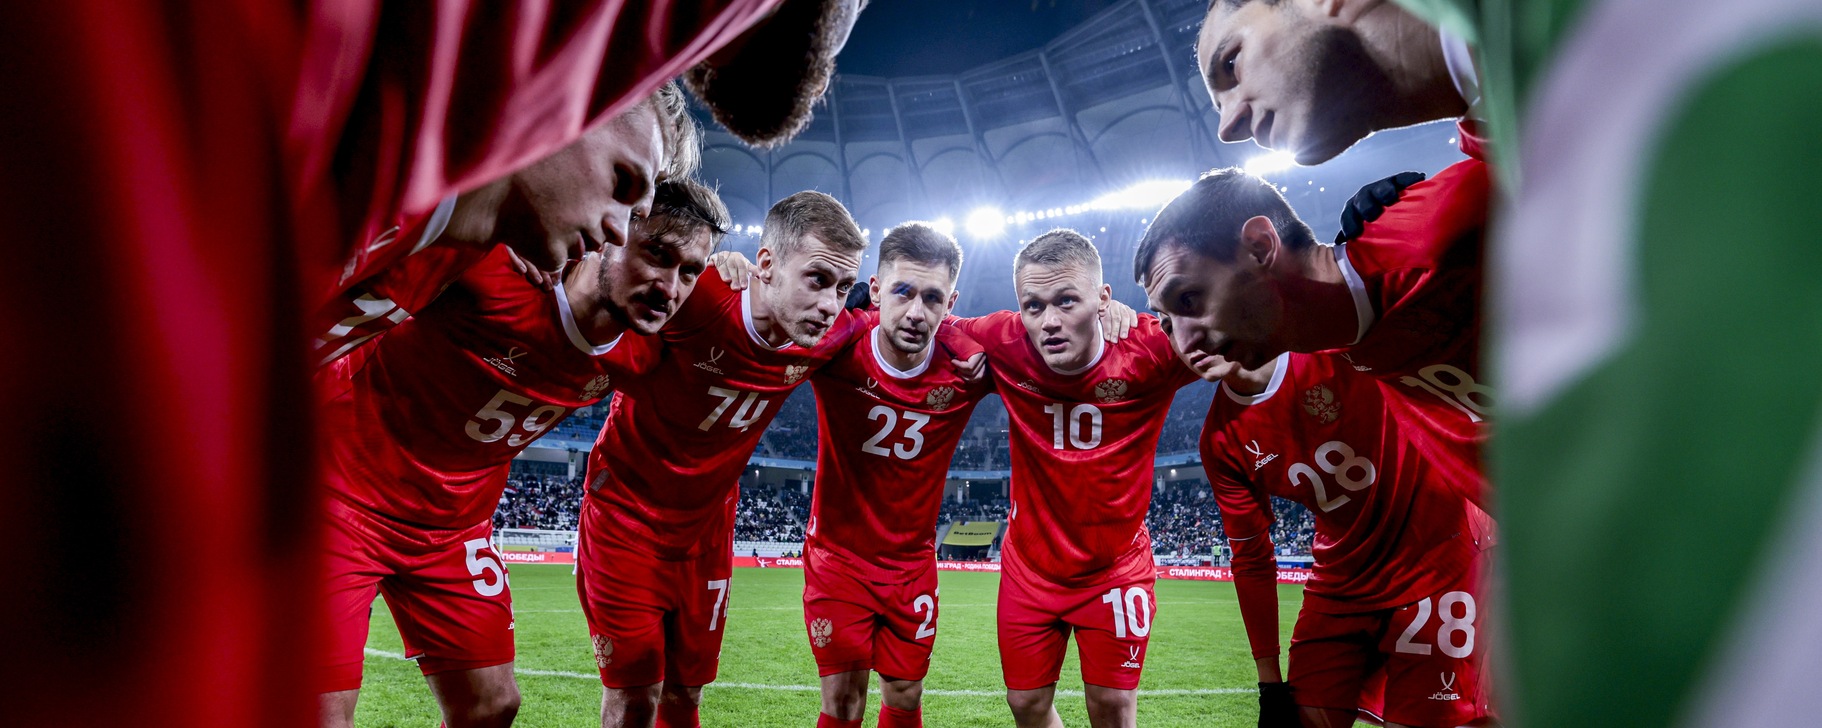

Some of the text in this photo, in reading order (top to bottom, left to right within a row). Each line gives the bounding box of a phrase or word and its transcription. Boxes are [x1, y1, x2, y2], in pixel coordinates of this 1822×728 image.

[483, 357, 517, 376] JÖGEL
[693, 362, 724, 375] JÖGEL
[464, 388, 566, 447] 59
[698, 386, 769, 432] 74
[1400, 364, 1494, 423] 18
[861, 405, 931, 460] 23
[1044, 403, 1103, 450] 10
[1288, 440, 1377, 513] 28
[502, 553, 545, 561] ПОБЕДЫ!
[1169, 569, 1222, 578] СТАЛИНГРАД
[913, 588, 940, 640] 2
[1102, 587, 1150, 638] 10
[1395, 591, 1476, 659] 28
